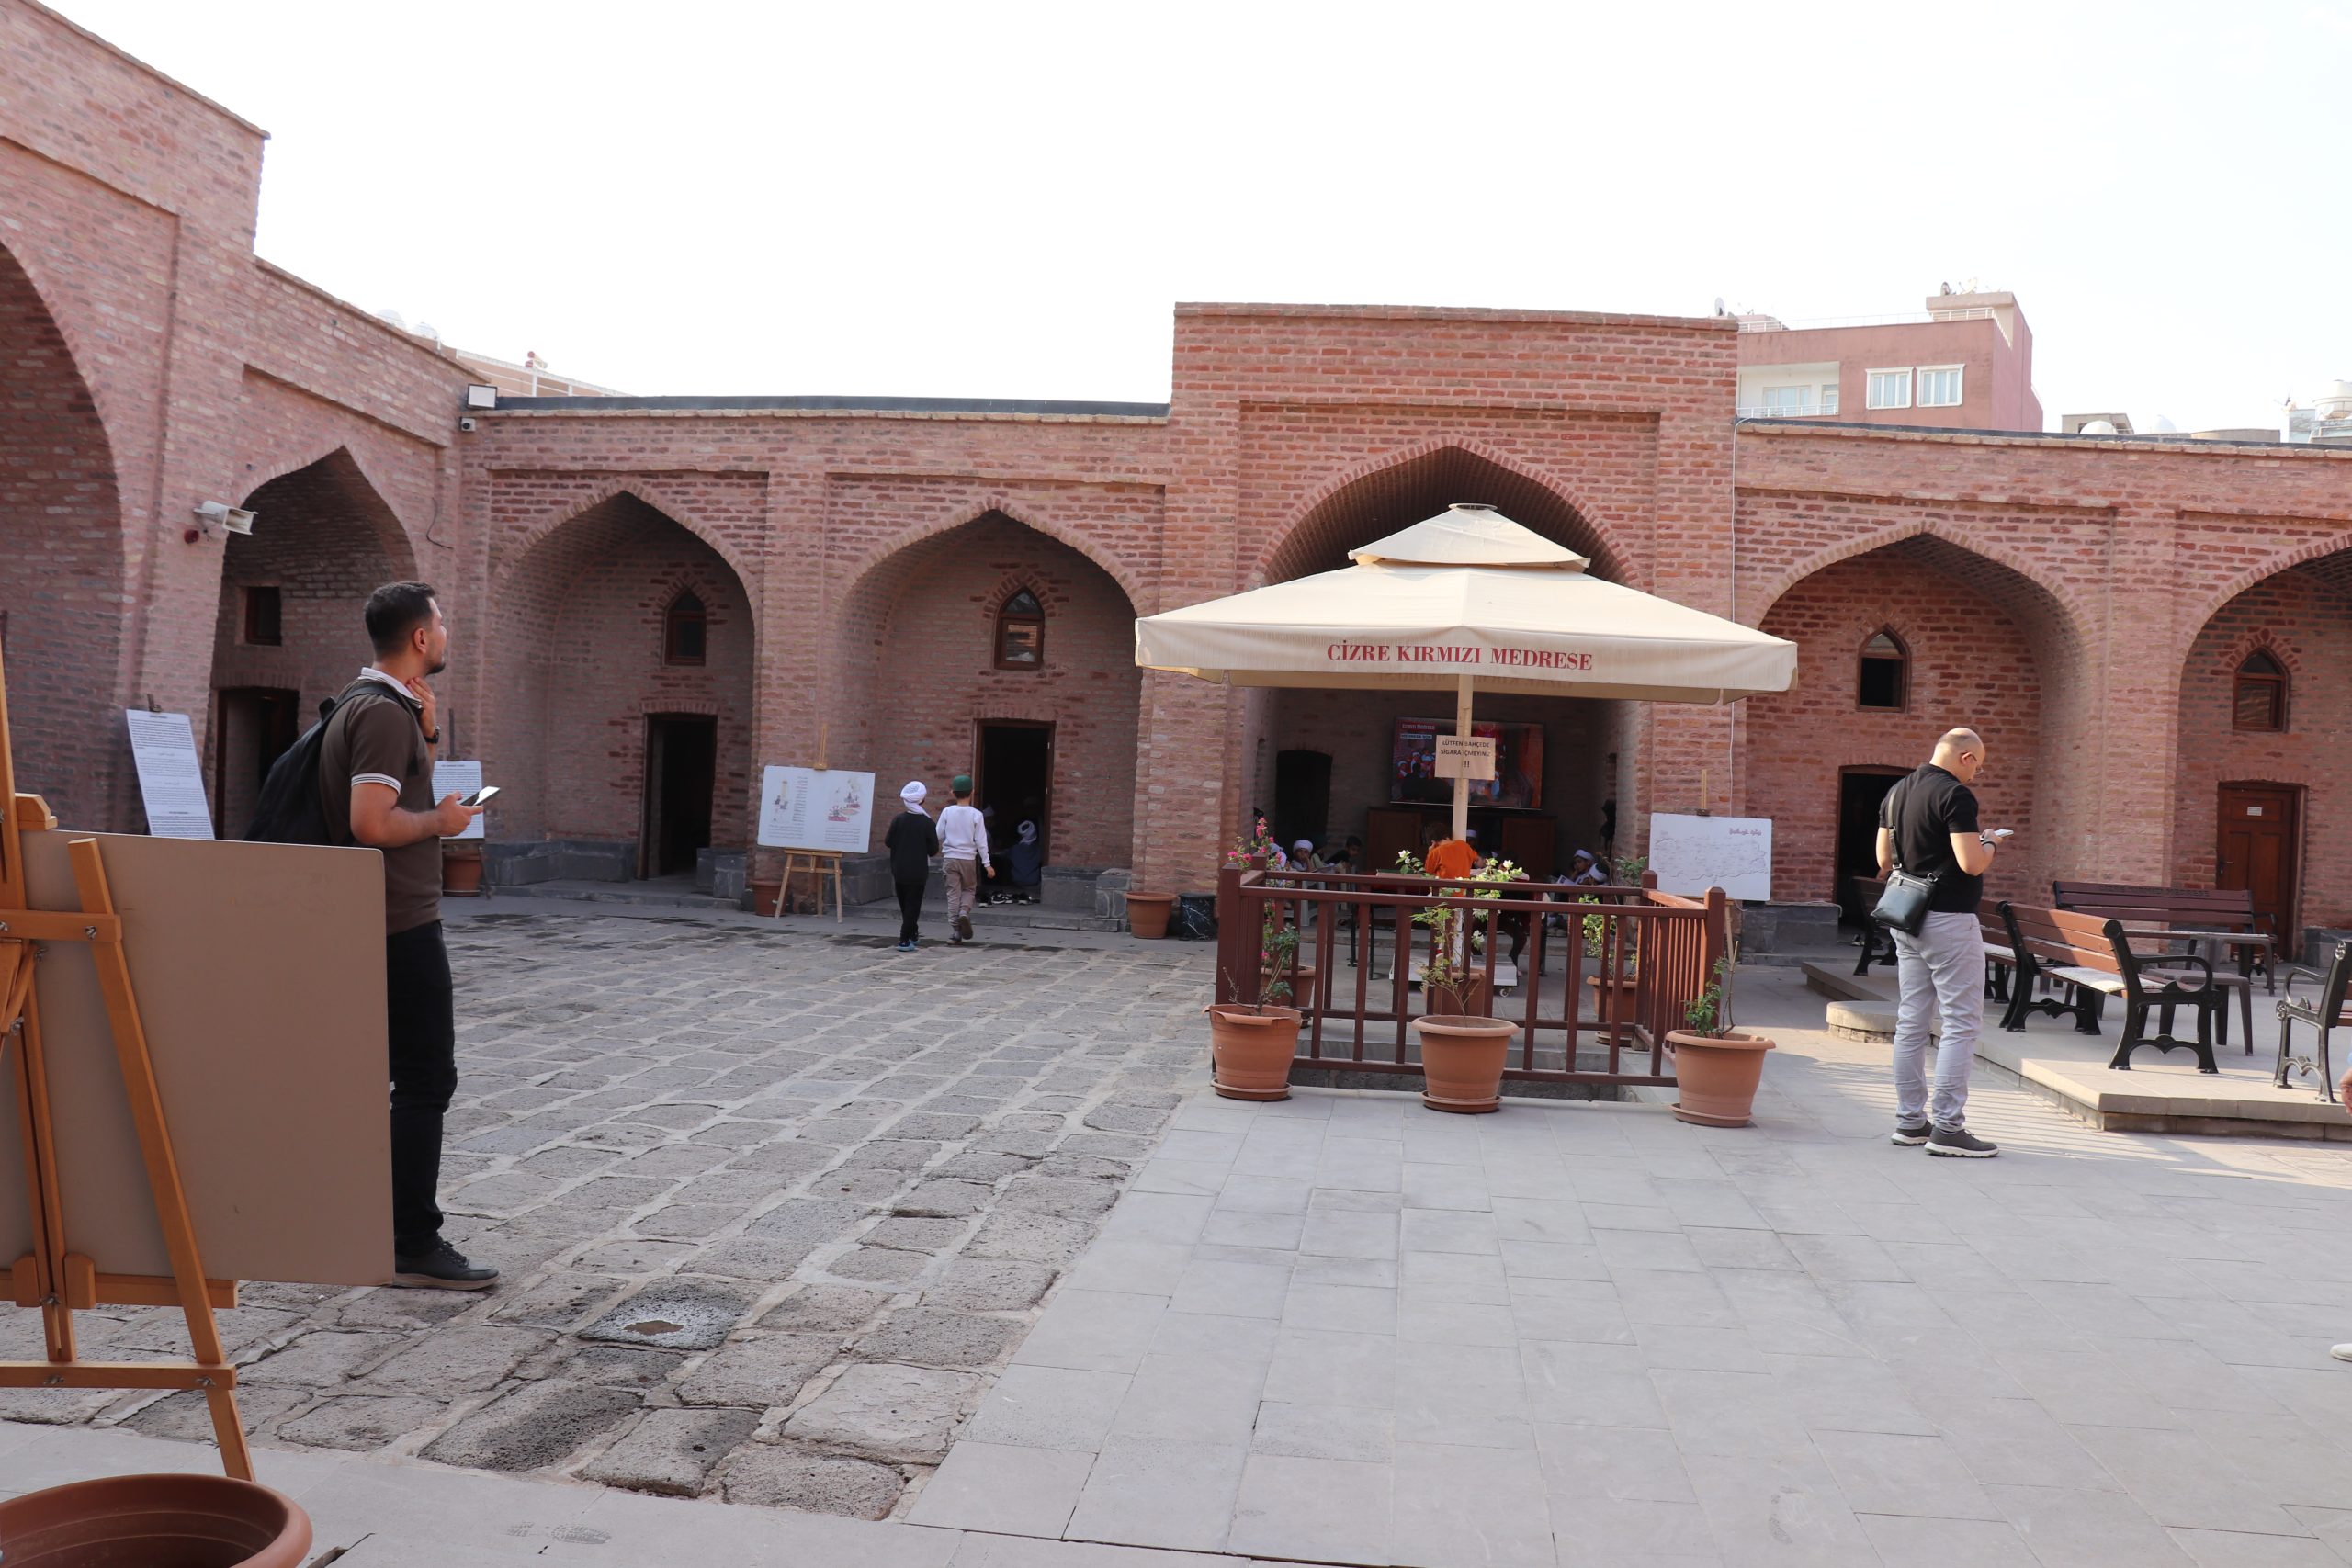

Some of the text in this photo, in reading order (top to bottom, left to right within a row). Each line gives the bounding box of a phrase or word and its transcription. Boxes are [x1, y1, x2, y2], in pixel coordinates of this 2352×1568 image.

[1327, 640, 1593, 671] CİZRE KIRMIZI MEDRESE
